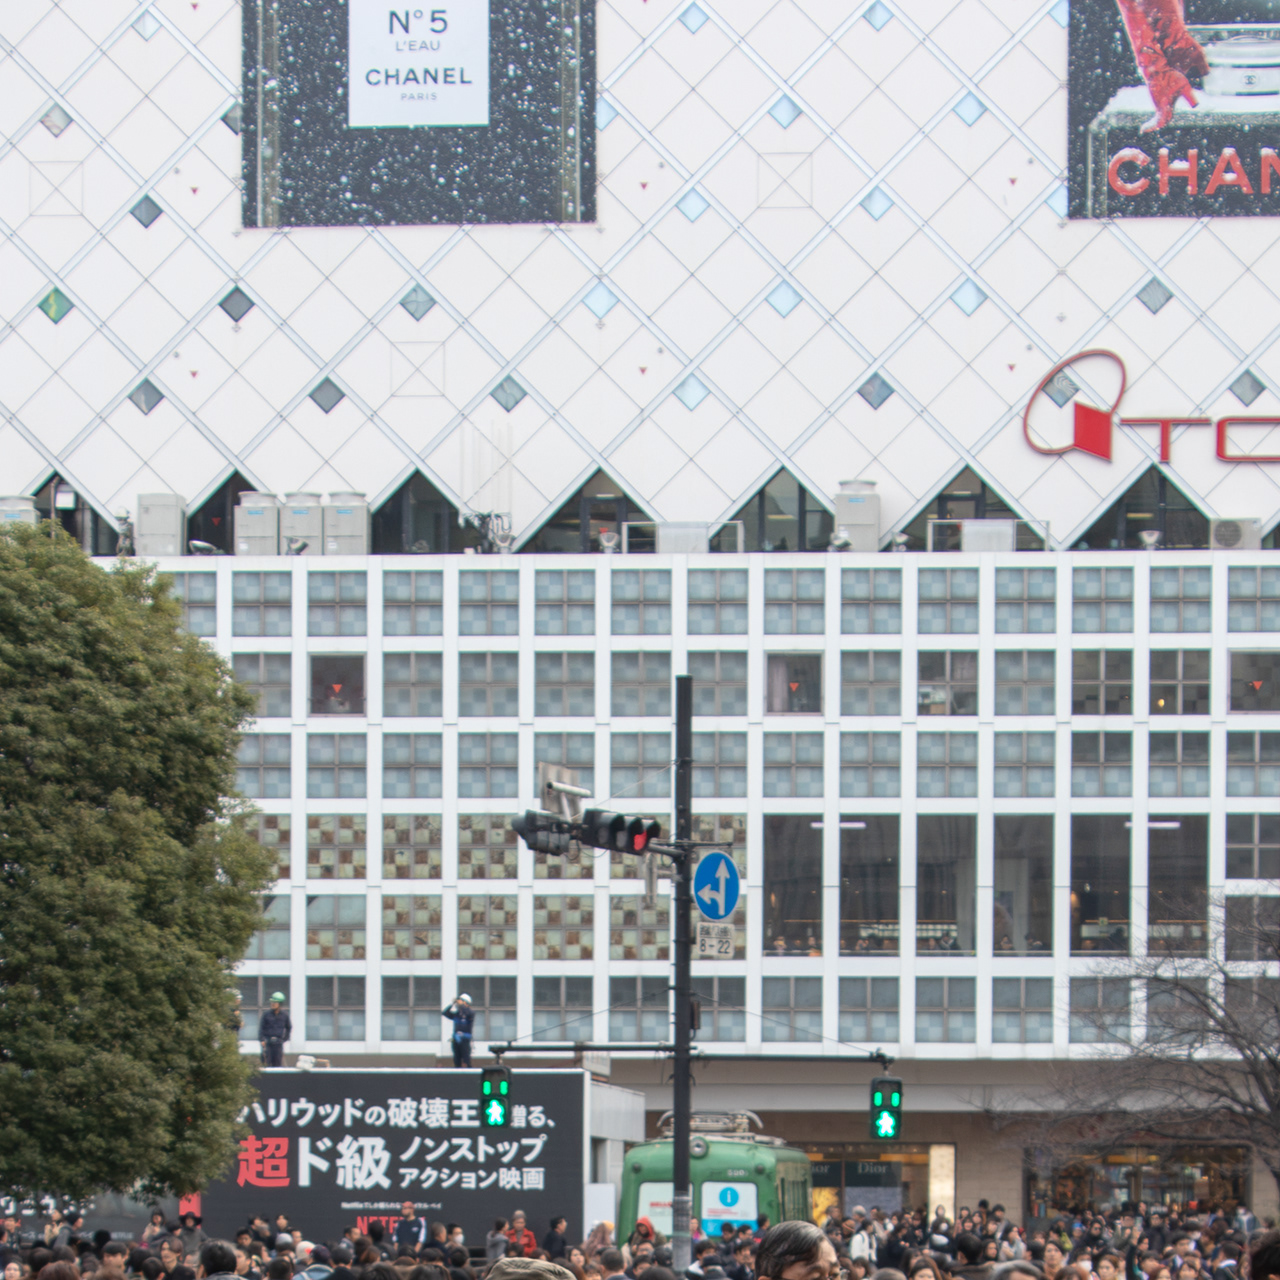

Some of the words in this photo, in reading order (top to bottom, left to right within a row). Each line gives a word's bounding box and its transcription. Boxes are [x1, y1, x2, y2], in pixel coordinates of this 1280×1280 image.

[396, 40, 441, 52] L'EAU
[365, 67, 472, 86] CHANEL
[401, 92, 438, 101] PARIS
[236, 1134, 392, 1190] 超ド級
[399, 1133, 548, 1163] ノンストップ
[811, 1162, 830, 1174] ior
[858, 1162, 888, 1174] Dior
[398, 1166, 545, 1191] アクション映画
